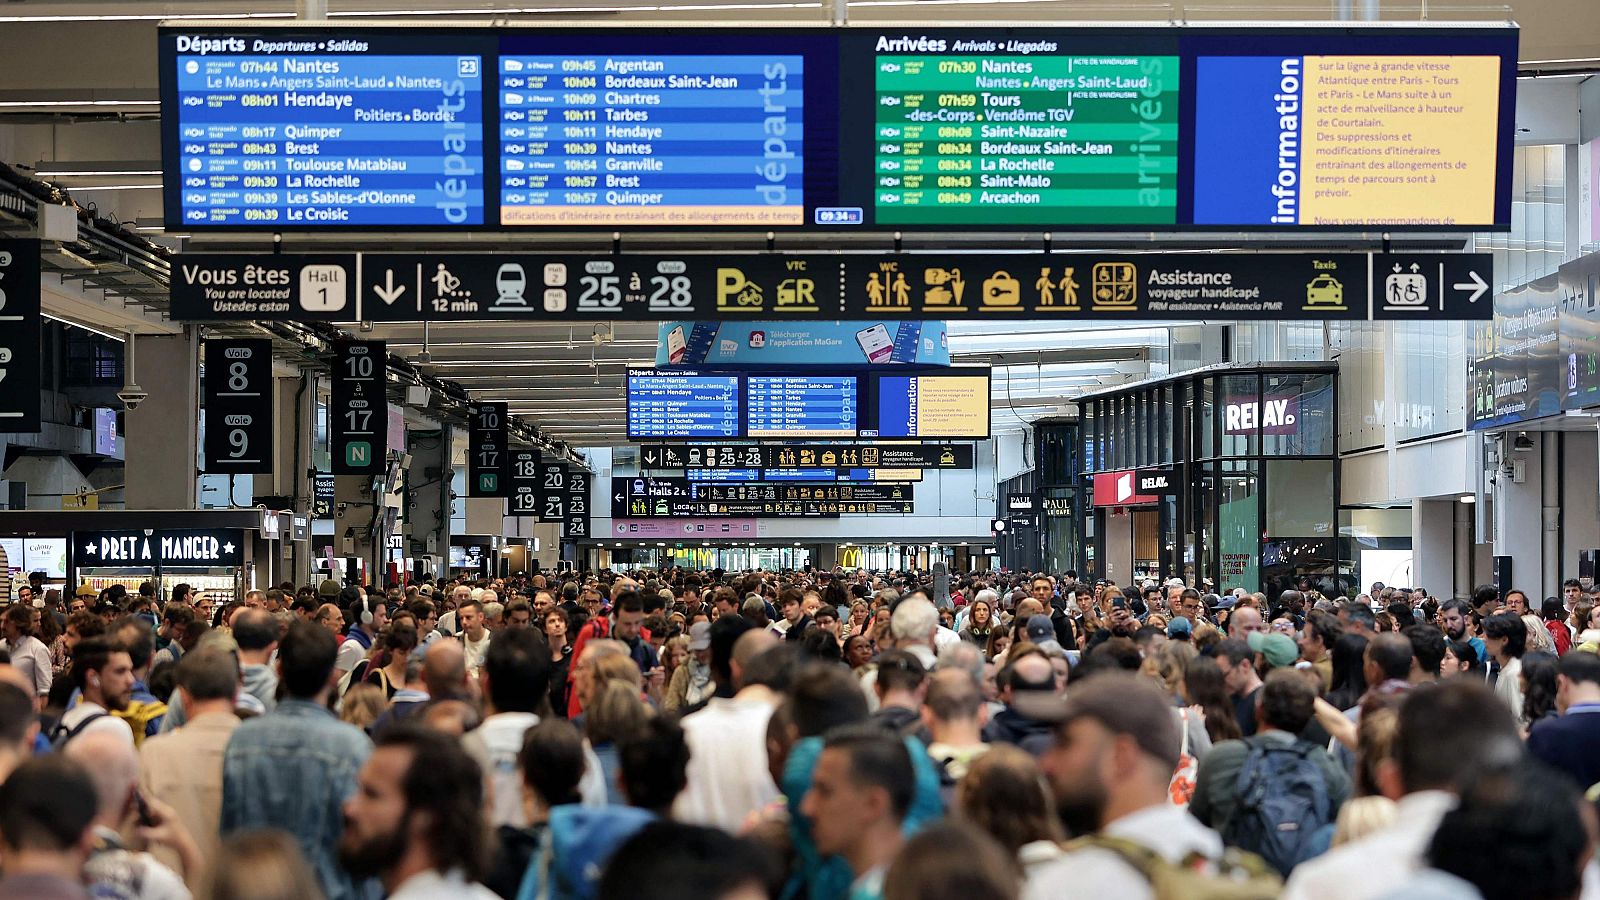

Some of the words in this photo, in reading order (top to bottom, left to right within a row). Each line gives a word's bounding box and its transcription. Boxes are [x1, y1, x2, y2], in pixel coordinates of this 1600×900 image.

[177, 36, 245, 55] Départs
[253, 40, 316, 54] Departures
[327, 40, 368, 51] Salidas
[876, 36, 946, 51] Arrivées
[952, 40, 996, 51] Arrivals
[1007, 40, 1057, 54] Llegadas
[284, 59, 339, 73] Nantes
[605, 59, 663, 74] Argentan
[939, 62, 976, 73] 07h30
[982, 60, 1032, 73] Nantes
[1347, 62, 1371, 72] ligne
[1381, 62, 1414, 73] grande
[1417, 62, 1450, 71] vitesse
[207, 76, 222, 88] Le
[226, 76, 259, 88] Mans
[270, 76, 313, 91] Angers
[316, 76, 385, 88] Saint-Laud
[396, 76, 441, 88] Nantes
[605, 73, 665, 88] Bordeaux
[669, 75, 737, 88] Saint-Jean
[976, 76, 1022, 88] Nantes
[1031, 76, 1075, 91] Angers
[1077, 74, 1148, 89] Saint-Laud
[1318, 76, 1368, 86] Atlantique
[1400, 76, 1422, 84] Paris
[1433, 76, 1458, 85] Tours
[605, 92, 660, 104] Chartres
[981, 93, 1020, 106] Tours
[1331, 90, 1353, 98] Paris
[1363, 91, 1374, 99] Le
[1405, 90, 1428, 99] suite
[285, 92, 352, 110] Hendaye
[605, 108, 648, 121] Tarbes
[1341, 105, 1352, 113] de
[1355, 104, 1414, 113] malveillance
[1426, 104, 1463, 113] hauteur
[355, 109, 403, 121] Poitiers
[904, 109, 974, 124] -des-Corps
[985, 109, 1045, 121] Vendôme
[1047, 109, 1074, 121] TGV
[1317, 119, 1328, 127] de
[285, 125, 341, 140] Quimper
[606, 125, 662, 140] Hendaye
[756, 62, 795, 205] départs
[981, 125, 1067, 137] Saint-Nazaire
[1131, 57, 1163, 207] arrivées
[1271, 58, 1300, 223] information
[1317, 132, 1335, 141] Des
[1337, 132, 1399, 143] suppressions
[286, 142, 319, 154] Brest
[437, 80, 475, 223] départs
[606, 142, 652, 154] Nantes
[981, 142, 1041, 154] Bordeaux
[1044, 142, 1112, 154] Saint-Jean
[1316, 146, 1382, 155] modifications
[286, 158, 344, 170] Toulouse
[347, 159, 406, 170] Matabiau
[606, 158, 663, 170] Granville
[981, 159, 996, 170] La
[999, 158, 1054, 170] Rochelle
[1368, 160, 1385, 169] des
[1387, 161, 1452, 171] allongements
[1455, 161, 1467, 169] de
[287, 175, 301, 187] La
[305, 175, 360, 187] Rochelle
[606, 175, 640, 187] Brest
[981, 175, 1050, 187] Saint-Malo
[1316, 176, 1345, 184] temps
[1348, 175, 1360, 183] de
[1363, 176, 1403, 184] parcours
[286, 190, 304, 205] Les
[309, 190, 412, 204] Sables-d'Olonne
[605, 190, 663, 207] Quimper
[980, 191, 1040, 203] Arcachon
[287, 208, 303, 220] Le
[305, 208, 348, 220] Croisic
[786, 261, 806, 270] VTC
[879, 262, 897, 272] WC
[1313, 261, 1336, 269] Taxis
[183, 265, 237, 284] Vous
[244, 265, 289, 284] êtes
[309, 271, 338, 282] Hall
[1148, 270, 1231, 284] Assistance
[630, 272, 640, 290] à
[204, 287, 225, 299] You
[228, 289, 246, 299] are
[248, 287, 291, 299] located
[319, 287, 328, 304] 1
[579, 277, 621, 306] 25
[650, 276, 691, 306] 28
[1148, 289, 1199, 300] voyageur
[1202, 287, 1259, 300] handicapé
[213, 301, 258, 312] Ustedes
[432, 299, 448, 311] 12
[451, 299, 478, 311] min
[1169, 302, 1212, 310] assistance
[1219, 302, 1262, 310] Asistencia
[769, 331, 811, 341] Téléchargez
[769, 338, 813, 347] l'application
[814, 338, 843, 346] MaGare
[228, 348, 249, 358] Voie
[346, 357, 372, 376] 10
[229, 362, 248, 390] 8
[629, 369, 654, 377] Départs
[1495, 378, 1510, 398] Location
[1511, 375, 1527, 393] voitures
[839, 378, 854, 430] départs
[907, 377, 917, 436] information
[721, 385, 735, 436] départs
[1226, 399, 1289, 431] RELAY
[228, 415, 249, 425] Voie
[345, 410, 372, 430] 17
[479, 414, 498, 427] 10
[229, 429, 248, 457] 9
[351, 446, 366, 462] N
[479, 452, 498, 465] 17
[720, 453, 735, 464] 25
[746, 453, 761, 464] 28
[514, 461, 535, 477] 18
[483, 477, 494, 488] N
[545, 473, 562, 486] 20
[1142, 477, 1164, 489] RELAY
[570, 480, 584, 492] 22
[649, 487, 672, 495] Halls
[674, 487, 679, 495] 2
[515, 494, 534, 508] 19
[748, 491, 758, 499] 25
[765, 491, 775, 499] 28
[1010, 496, 1032, 504] PAUL
[546, 503, 563, 517] 21
[570, 502, 585, 513] 23
[1045, 499, 1071, 509] PAUL
[570, 523, 584, 533] 24
[102, 537, 137, 559] PRET
[162, 536, 219, 559] MANGER
